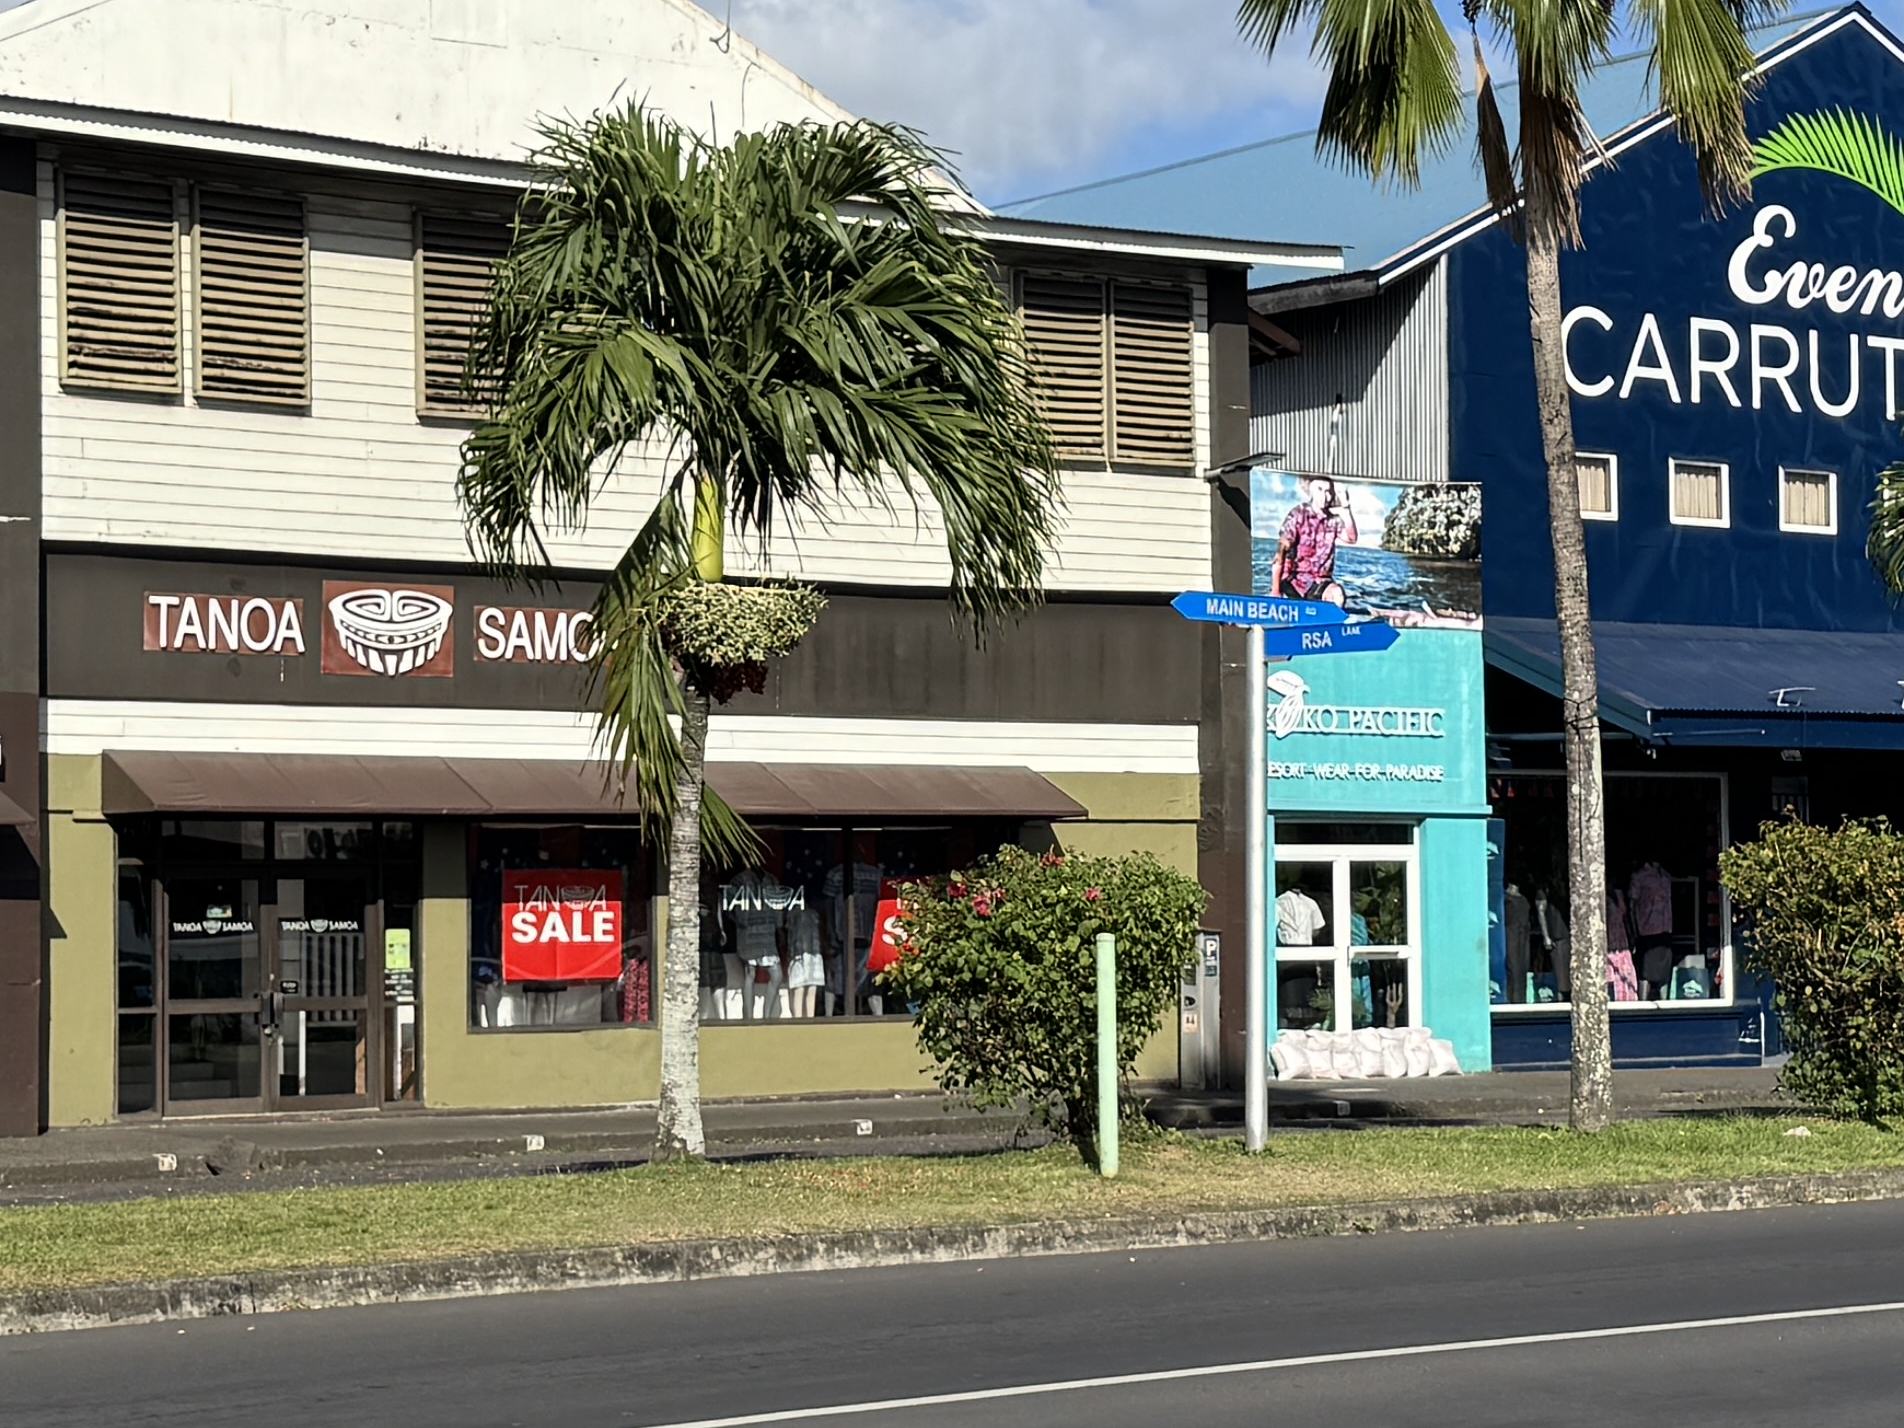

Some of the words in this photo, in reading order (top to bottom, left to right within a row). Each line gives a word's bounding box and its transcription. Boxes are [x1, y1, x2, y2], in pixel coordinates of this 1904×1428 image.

[1206, 598, 1244, 618] MAIN
[1247, 602, 1299, 622] BEACH
[148, 595, 306, 654] TANOA
[477, 606, 618, 663] SAMO
[1301, 630, 1333, 650] RSA
[1348, 707, 1446, 738] PACIFIC
[1267, 761, 1307, 780] ESORT
[1312, 762, 1350, 782] WEAR
[1354, 763, 1381, 782] FOR
[1385, 763, 1444, 782] PARADISE
[511, 910, 616, 944] SALE
